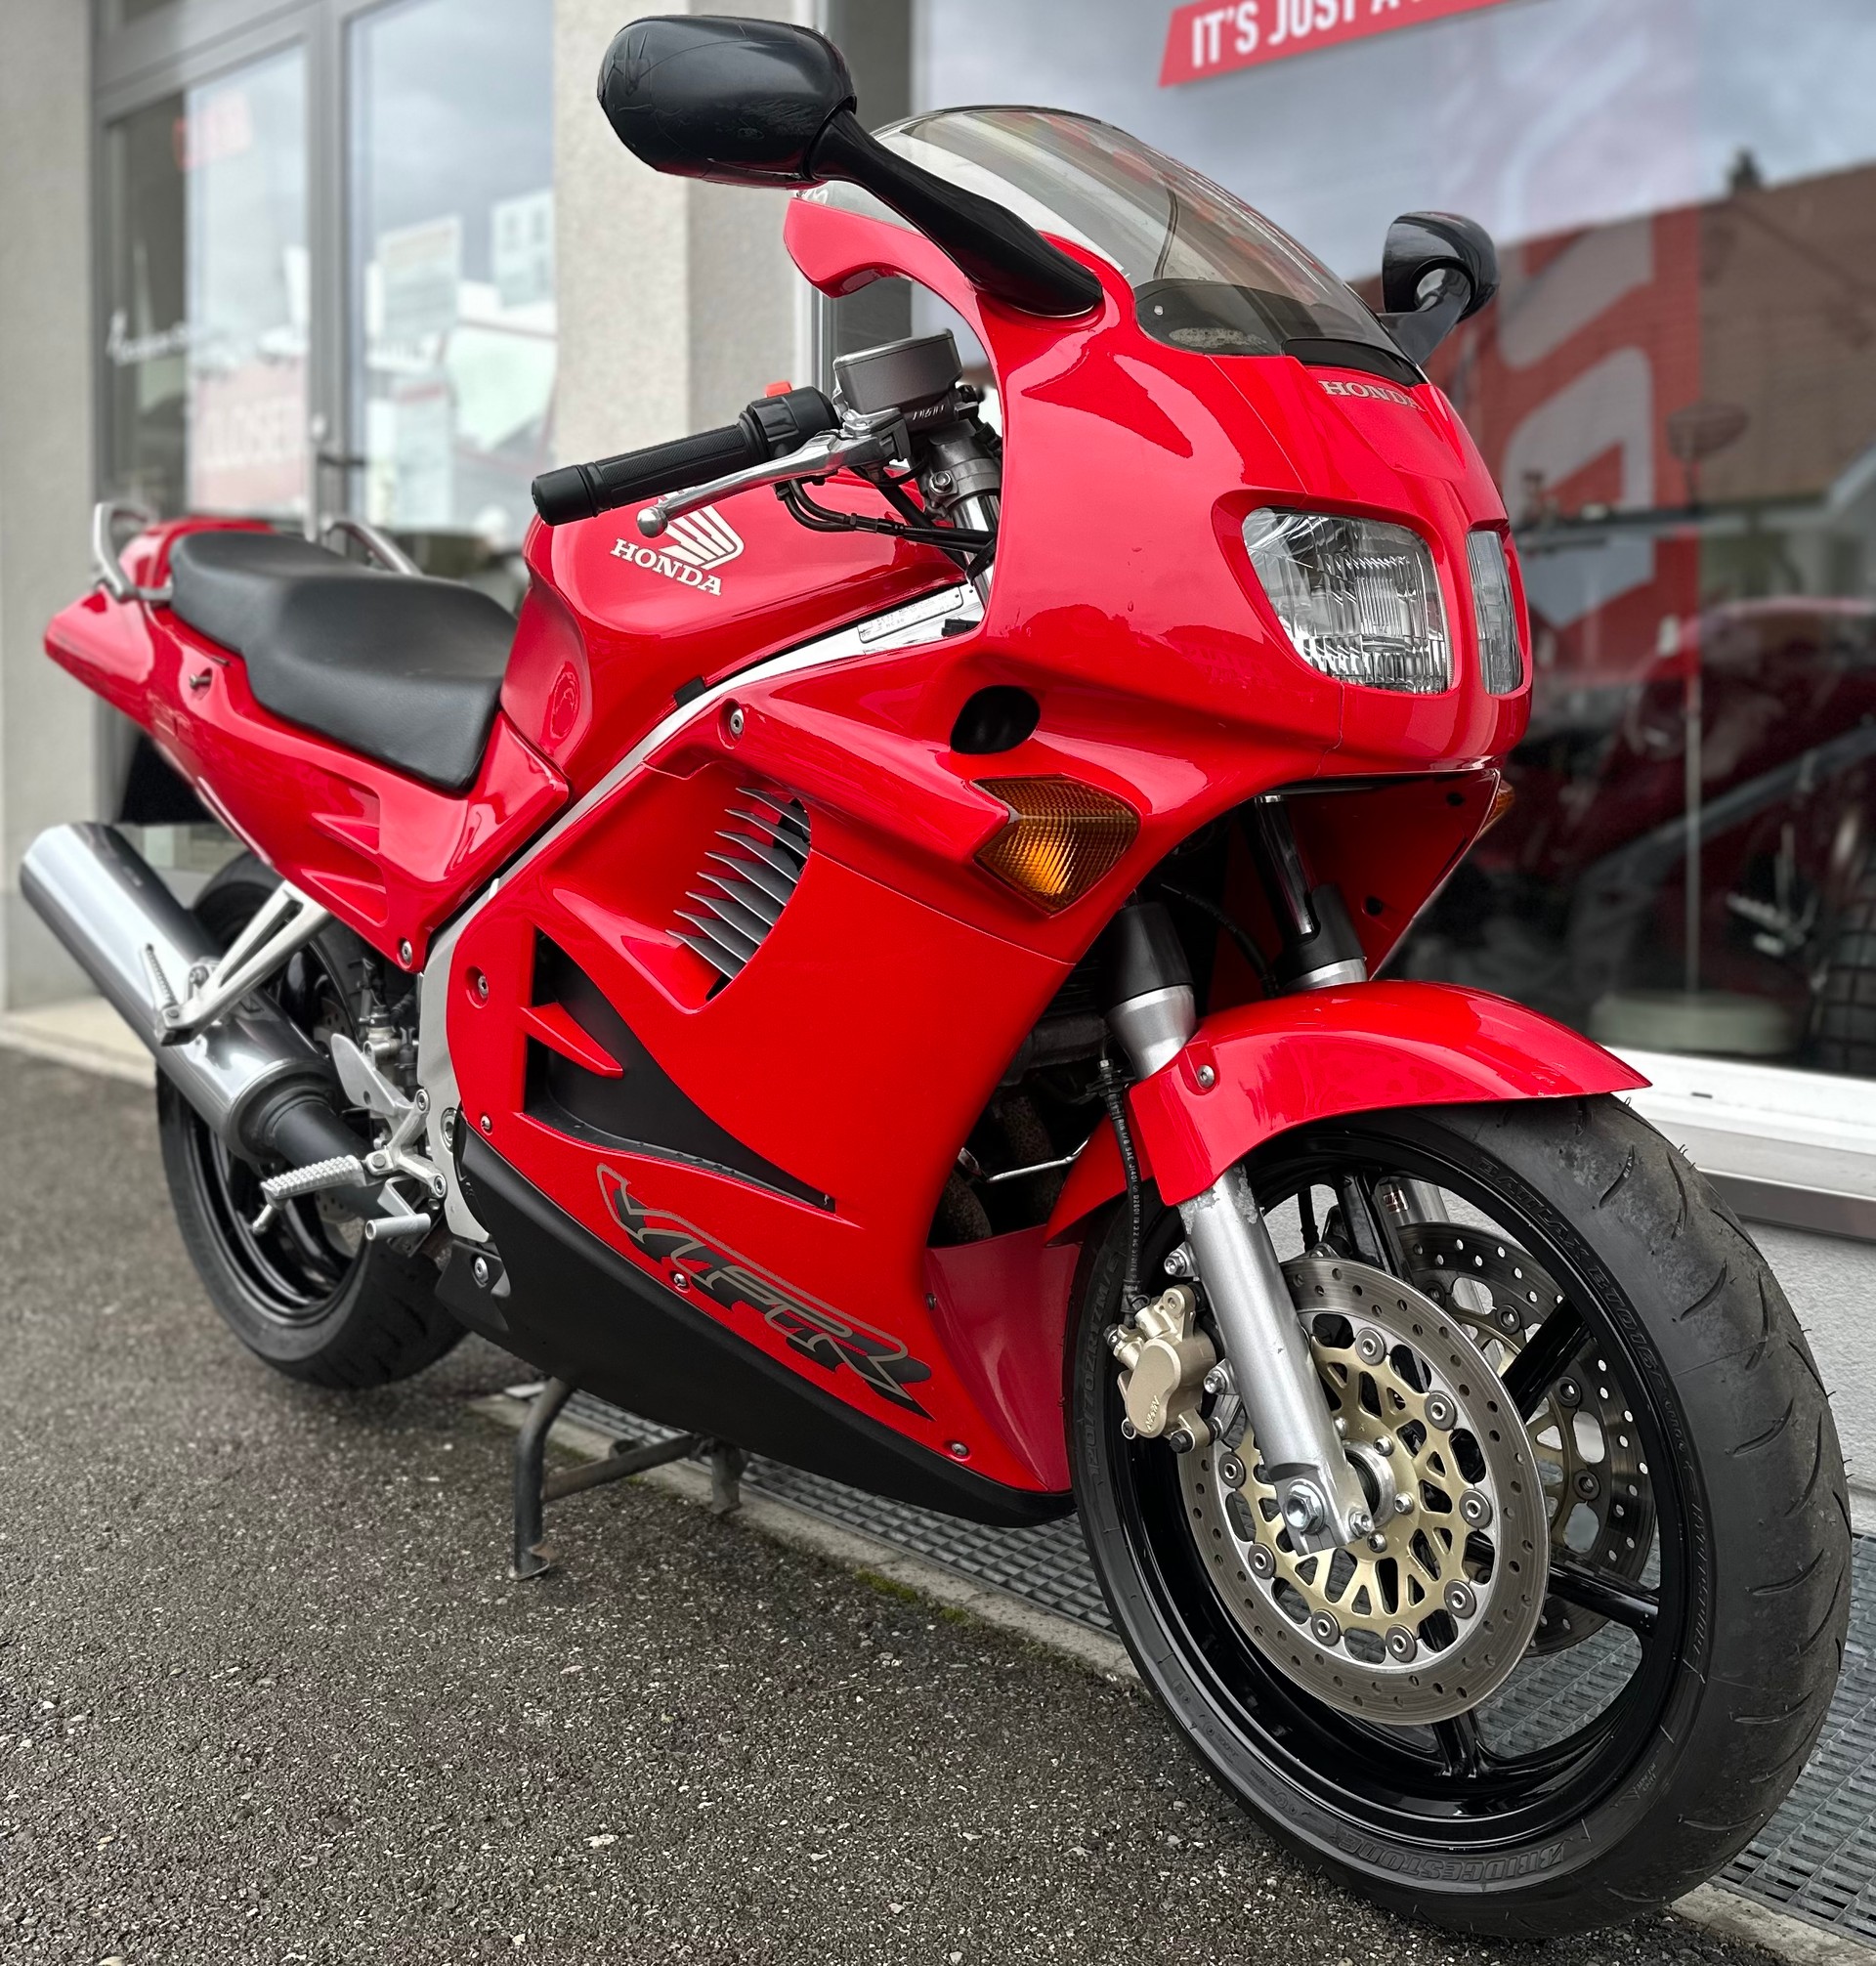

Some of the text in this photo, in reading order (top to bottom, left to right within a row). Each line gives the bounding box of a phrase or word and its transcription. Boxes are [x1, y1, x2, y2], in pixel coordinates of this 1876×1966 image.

[1192, 0, 1258, 68] IT'S
[1319, 380, 1426, 411] HONDA
[610, 538, 722, 596] HONDA
[1478, 1156, 1590, 1261] BATTLAX
[597, 1163, 936, 1422] VFR
[1337, 1833, 1564, 1882] BRIDGESTONE
